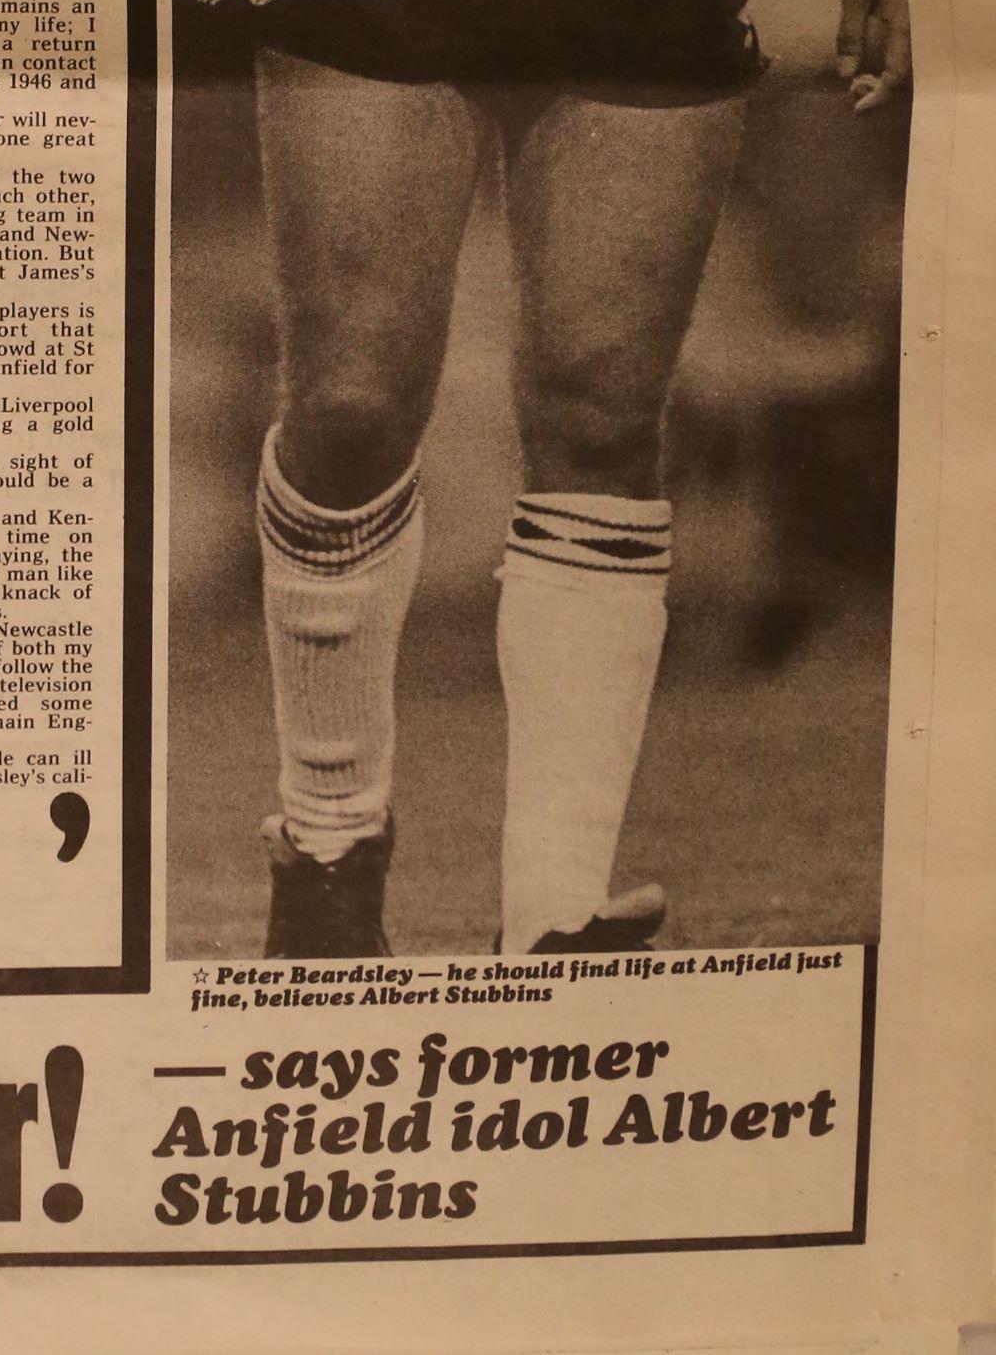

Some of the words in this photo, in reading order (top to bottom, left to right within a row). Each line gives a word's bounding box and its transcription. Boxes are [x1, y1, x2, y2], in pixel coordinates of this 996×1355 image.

[71, 1, 96, 15] an
[9, 72, 52, 90] 1946
[59, 73, 96, 90] and
[1, 396, 94, 417] Liverpool
[215, 966, 285, 986] Peter
[289, 964, 414, 986] Beardsley
[447, 963, 478, 982] he
[481, 960, 565, 981] should
[569, 958, 620, 982] find
[624, 957, 666, 981] life
[670, 957, 697, 975] at
[699, 952, 792, 977] Anfield
[796, 951, 843, 975] just
[190, 988, 248, 1013] fine,
[254, 988, 356, 1008] believes
[358, 986, 440, 1006] Albert
[444, 983, 553, 1005] Stubbins
[240, 1047, 401, 1099] says
[416, 1033, 670, 1097] former
[151, 1100, 432, 1166] Anfield
[450, 1095, 590, 1153] idol
[602, 1089, 837, 1146] Albert
[154, 1168, 478, 1227] Stubbins
